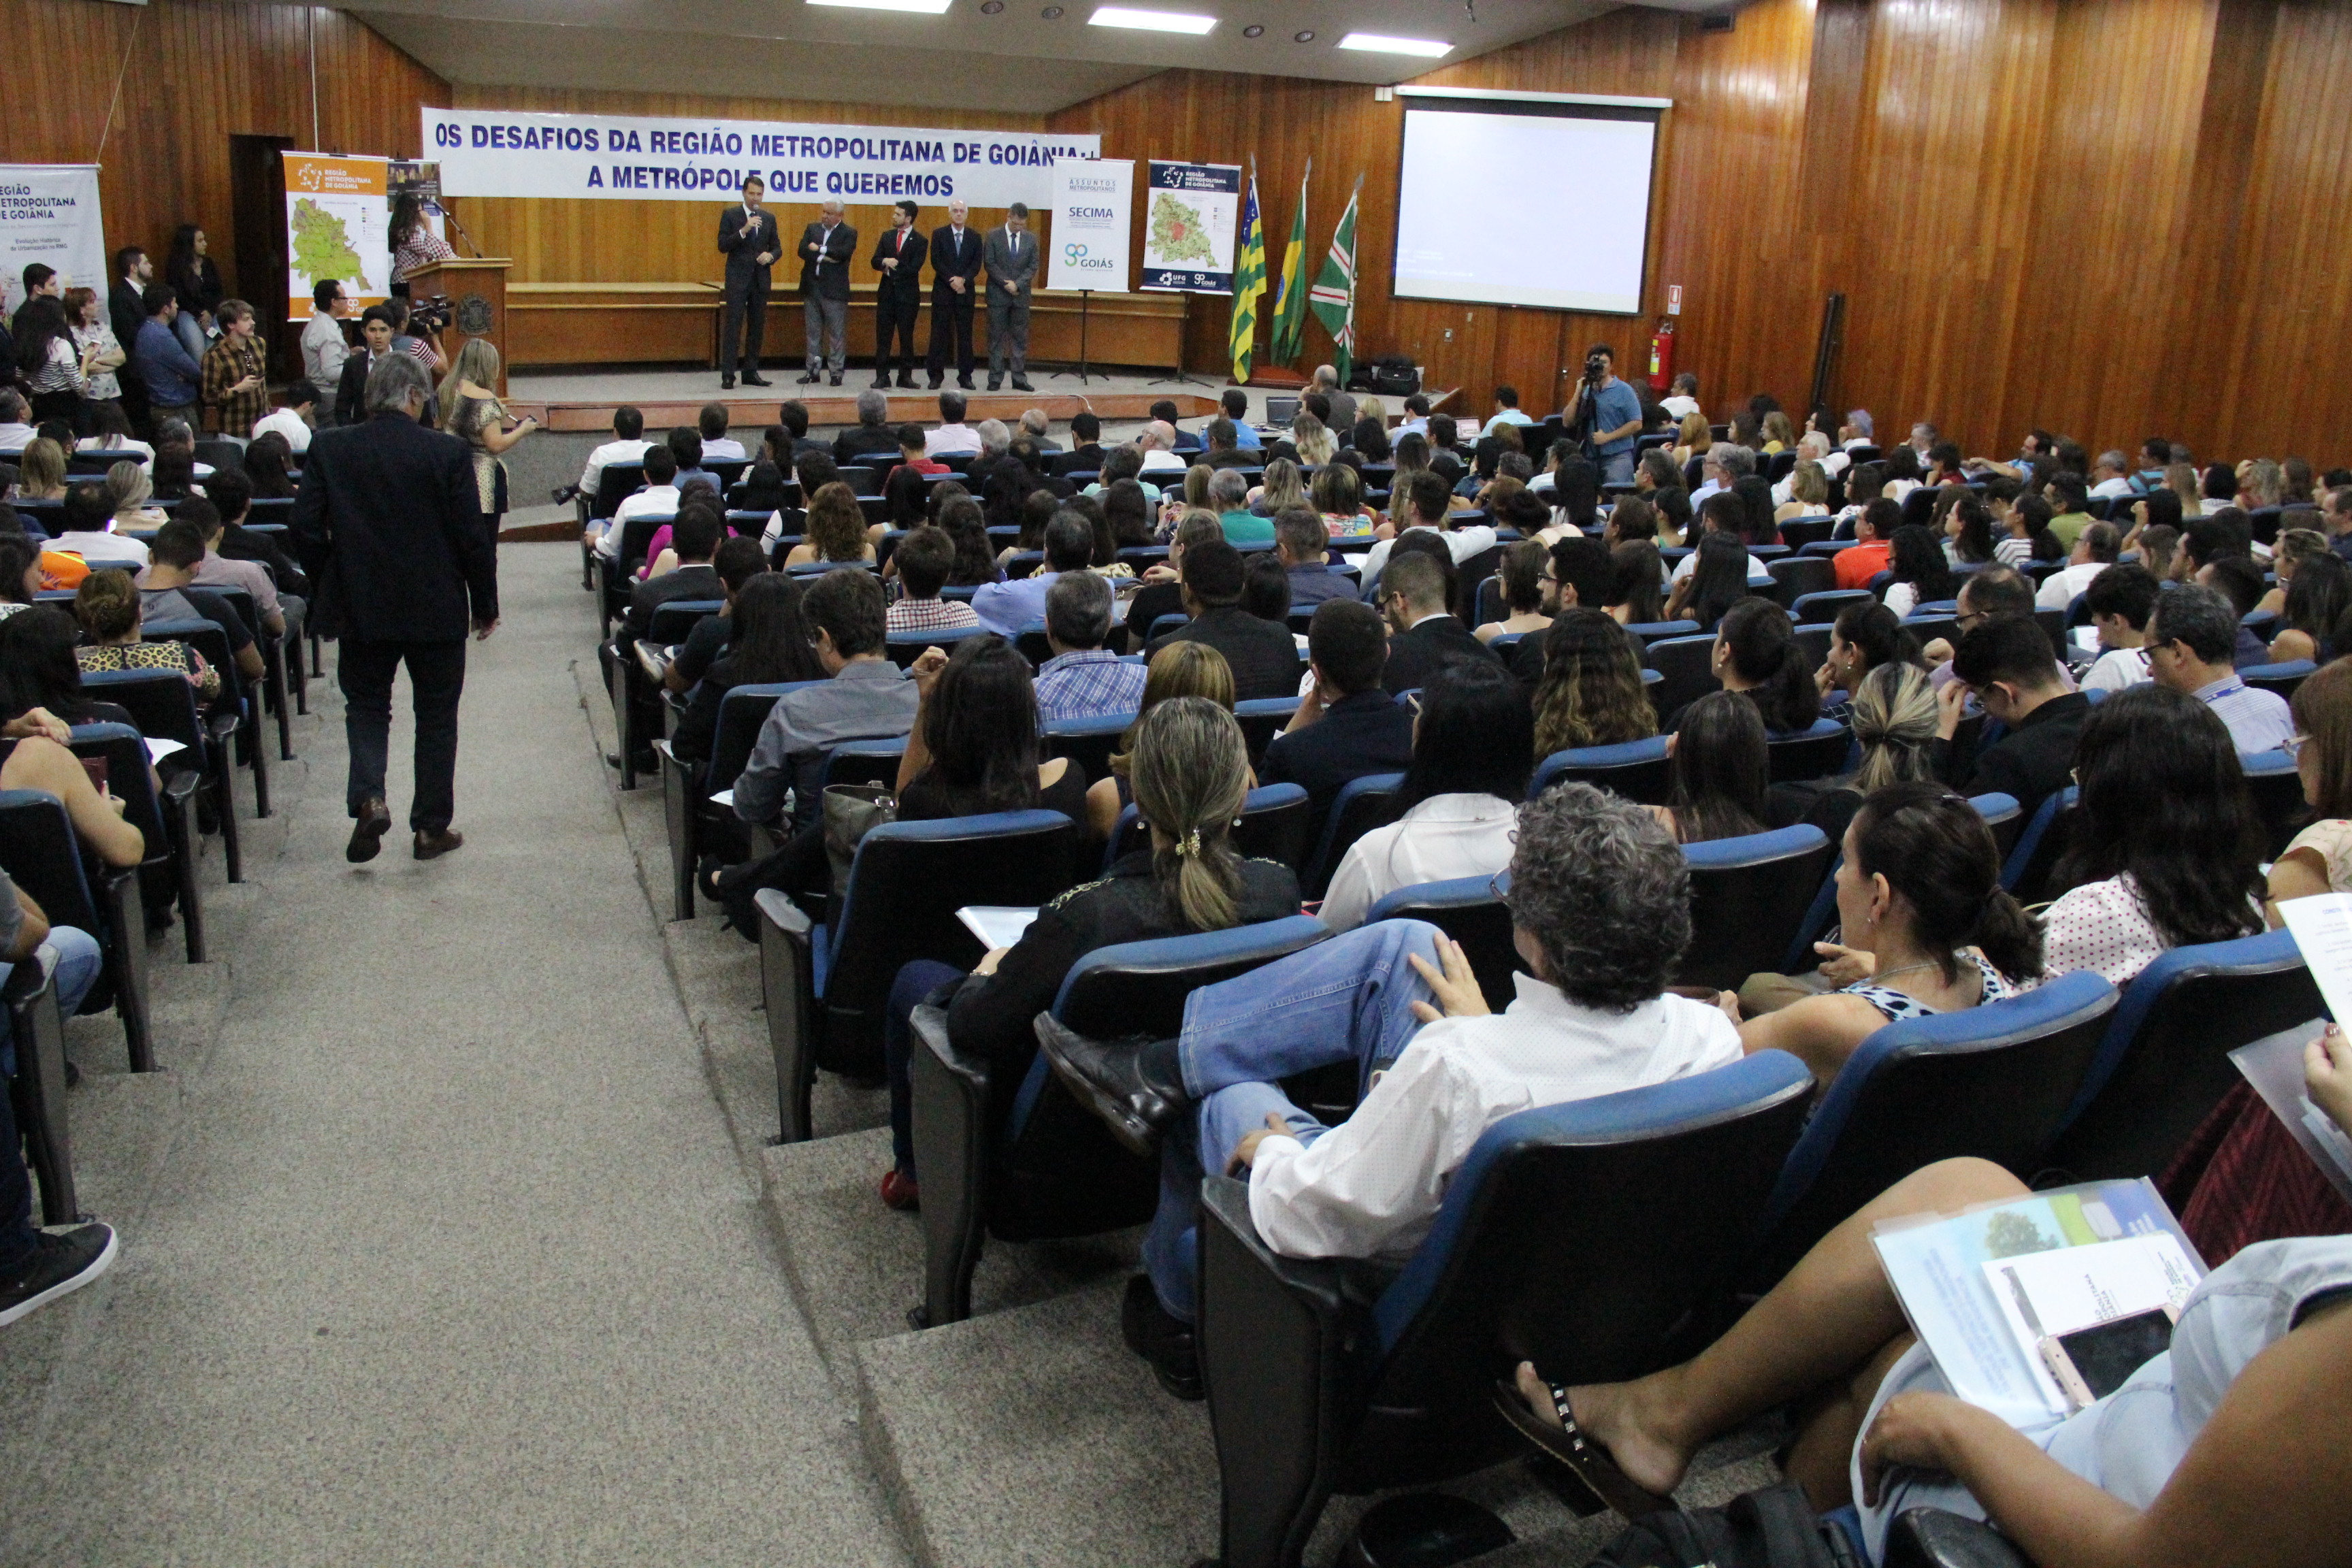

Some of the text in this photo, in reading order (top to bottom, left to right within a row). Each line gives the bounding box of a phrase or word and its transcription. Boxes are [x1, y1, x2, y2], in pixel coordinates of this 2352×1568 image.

[471, 125, 600, 152] DESAFIOS
[608, 129, 642, 152] DA
[651, 127, 742, 156] REGIÃO
[751, 134, 946, 163] METROPOLITANA
[953, 142, 981, 164] DE
[587, 165, 604, 188] A
[770, 169, 818, 194] QUE
[827, 171, 953, 197] QUEREMOS
[0, 183, 31, 195] EGIÃO
[0, 197, 76, 207] ETROPOLITANA
[0, 208, 54, 219] E GOIÂNIA
[1069, 207, 1113, 218] SECIMA
[1081, 258, 1113, 268] GOIÁS
